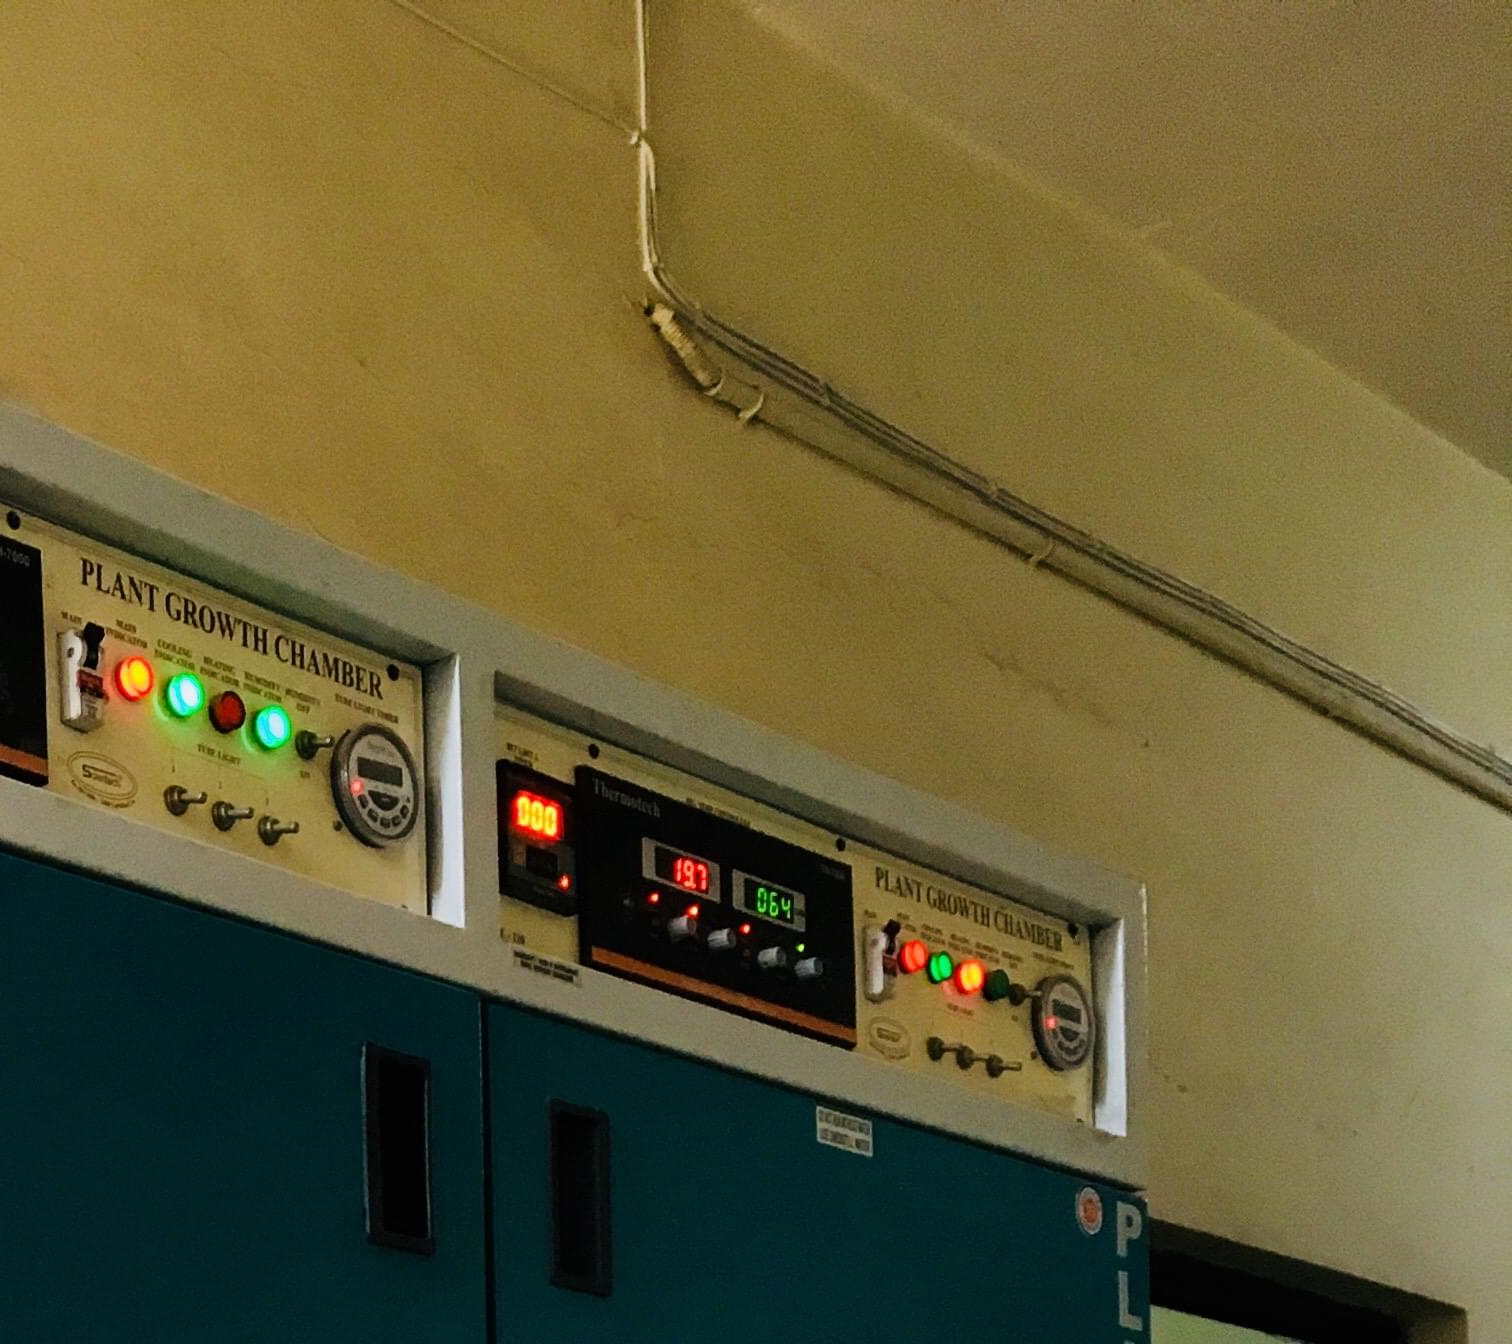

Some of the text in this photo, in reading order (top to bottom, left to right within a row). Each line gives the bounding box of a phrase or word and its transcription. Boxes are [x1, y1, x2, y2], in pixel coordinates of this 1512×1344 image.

[80, 557, 384, 700] PLANT GROWTH CHAMBER
[516, 795, 558, 838] 000
[592, 777, 661, 818] Thermotech
[757, 887, 792, 920] 064
[875, 865, 922, 904] PLANT
[925, 885, 990, 929] GROWTH
[993, 909, 1063, 952] CHAMBER
